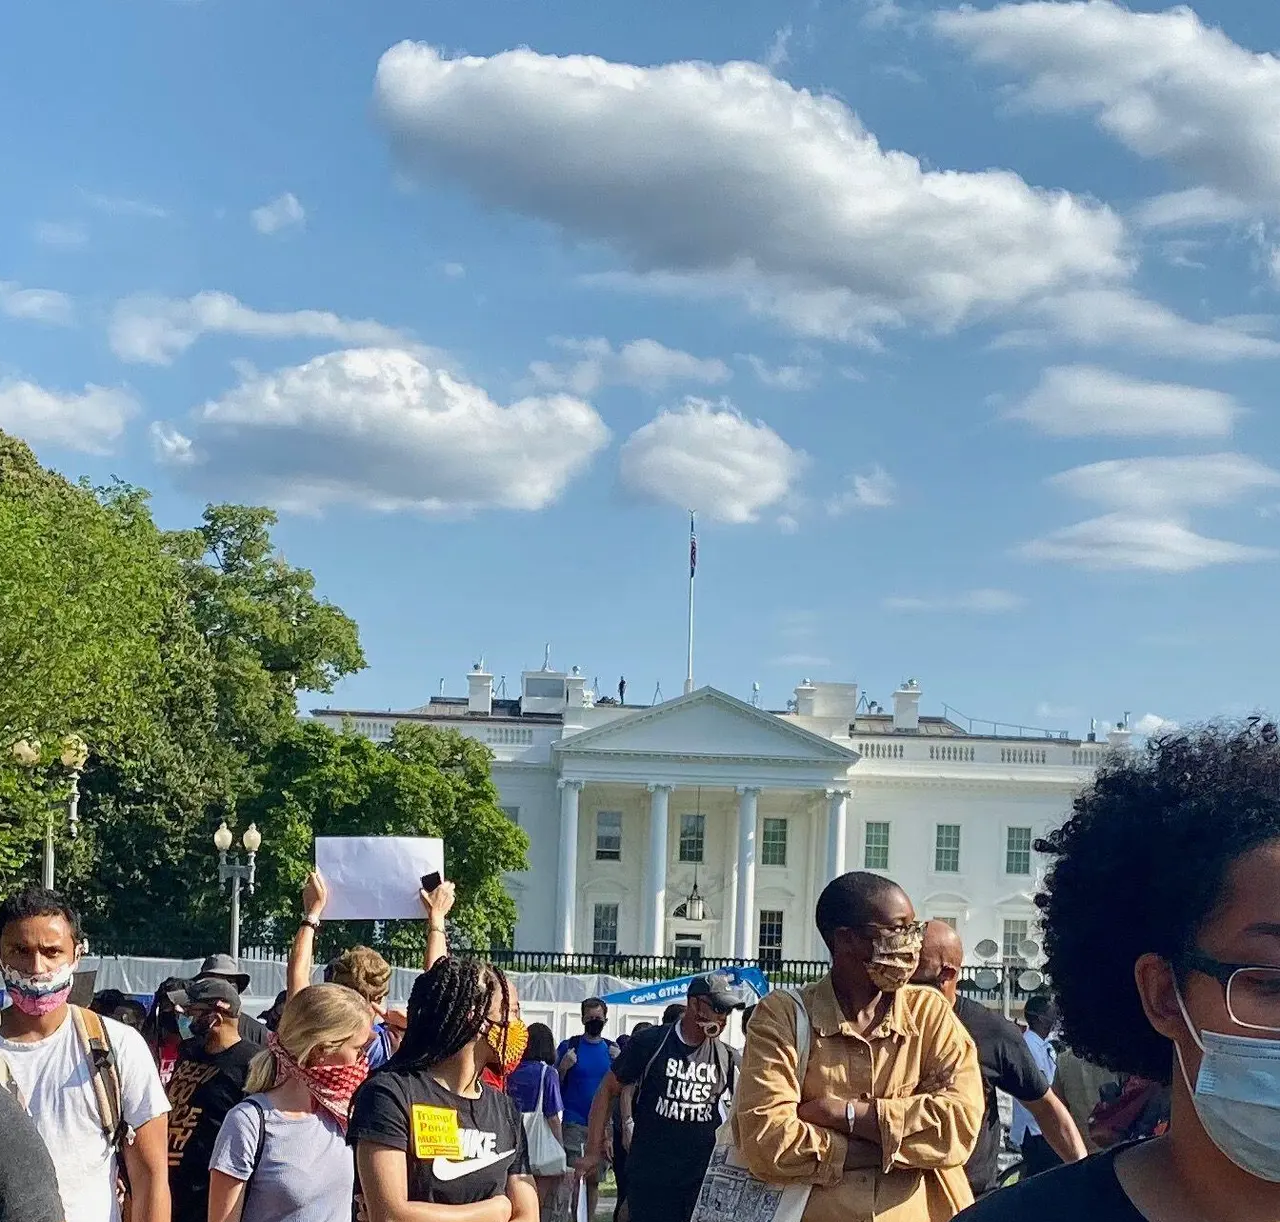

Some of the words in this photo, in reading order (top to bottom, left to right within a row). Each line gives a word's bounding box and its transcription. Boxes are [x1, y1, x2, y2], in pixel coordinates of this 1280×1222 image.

[630, 992, 657, 1004] Genie
[665, 1057, 717, 1084] BLACK
[666, 1079, 712, 1103] LIVES
[655, 1095, 713, 1122] MATTER
